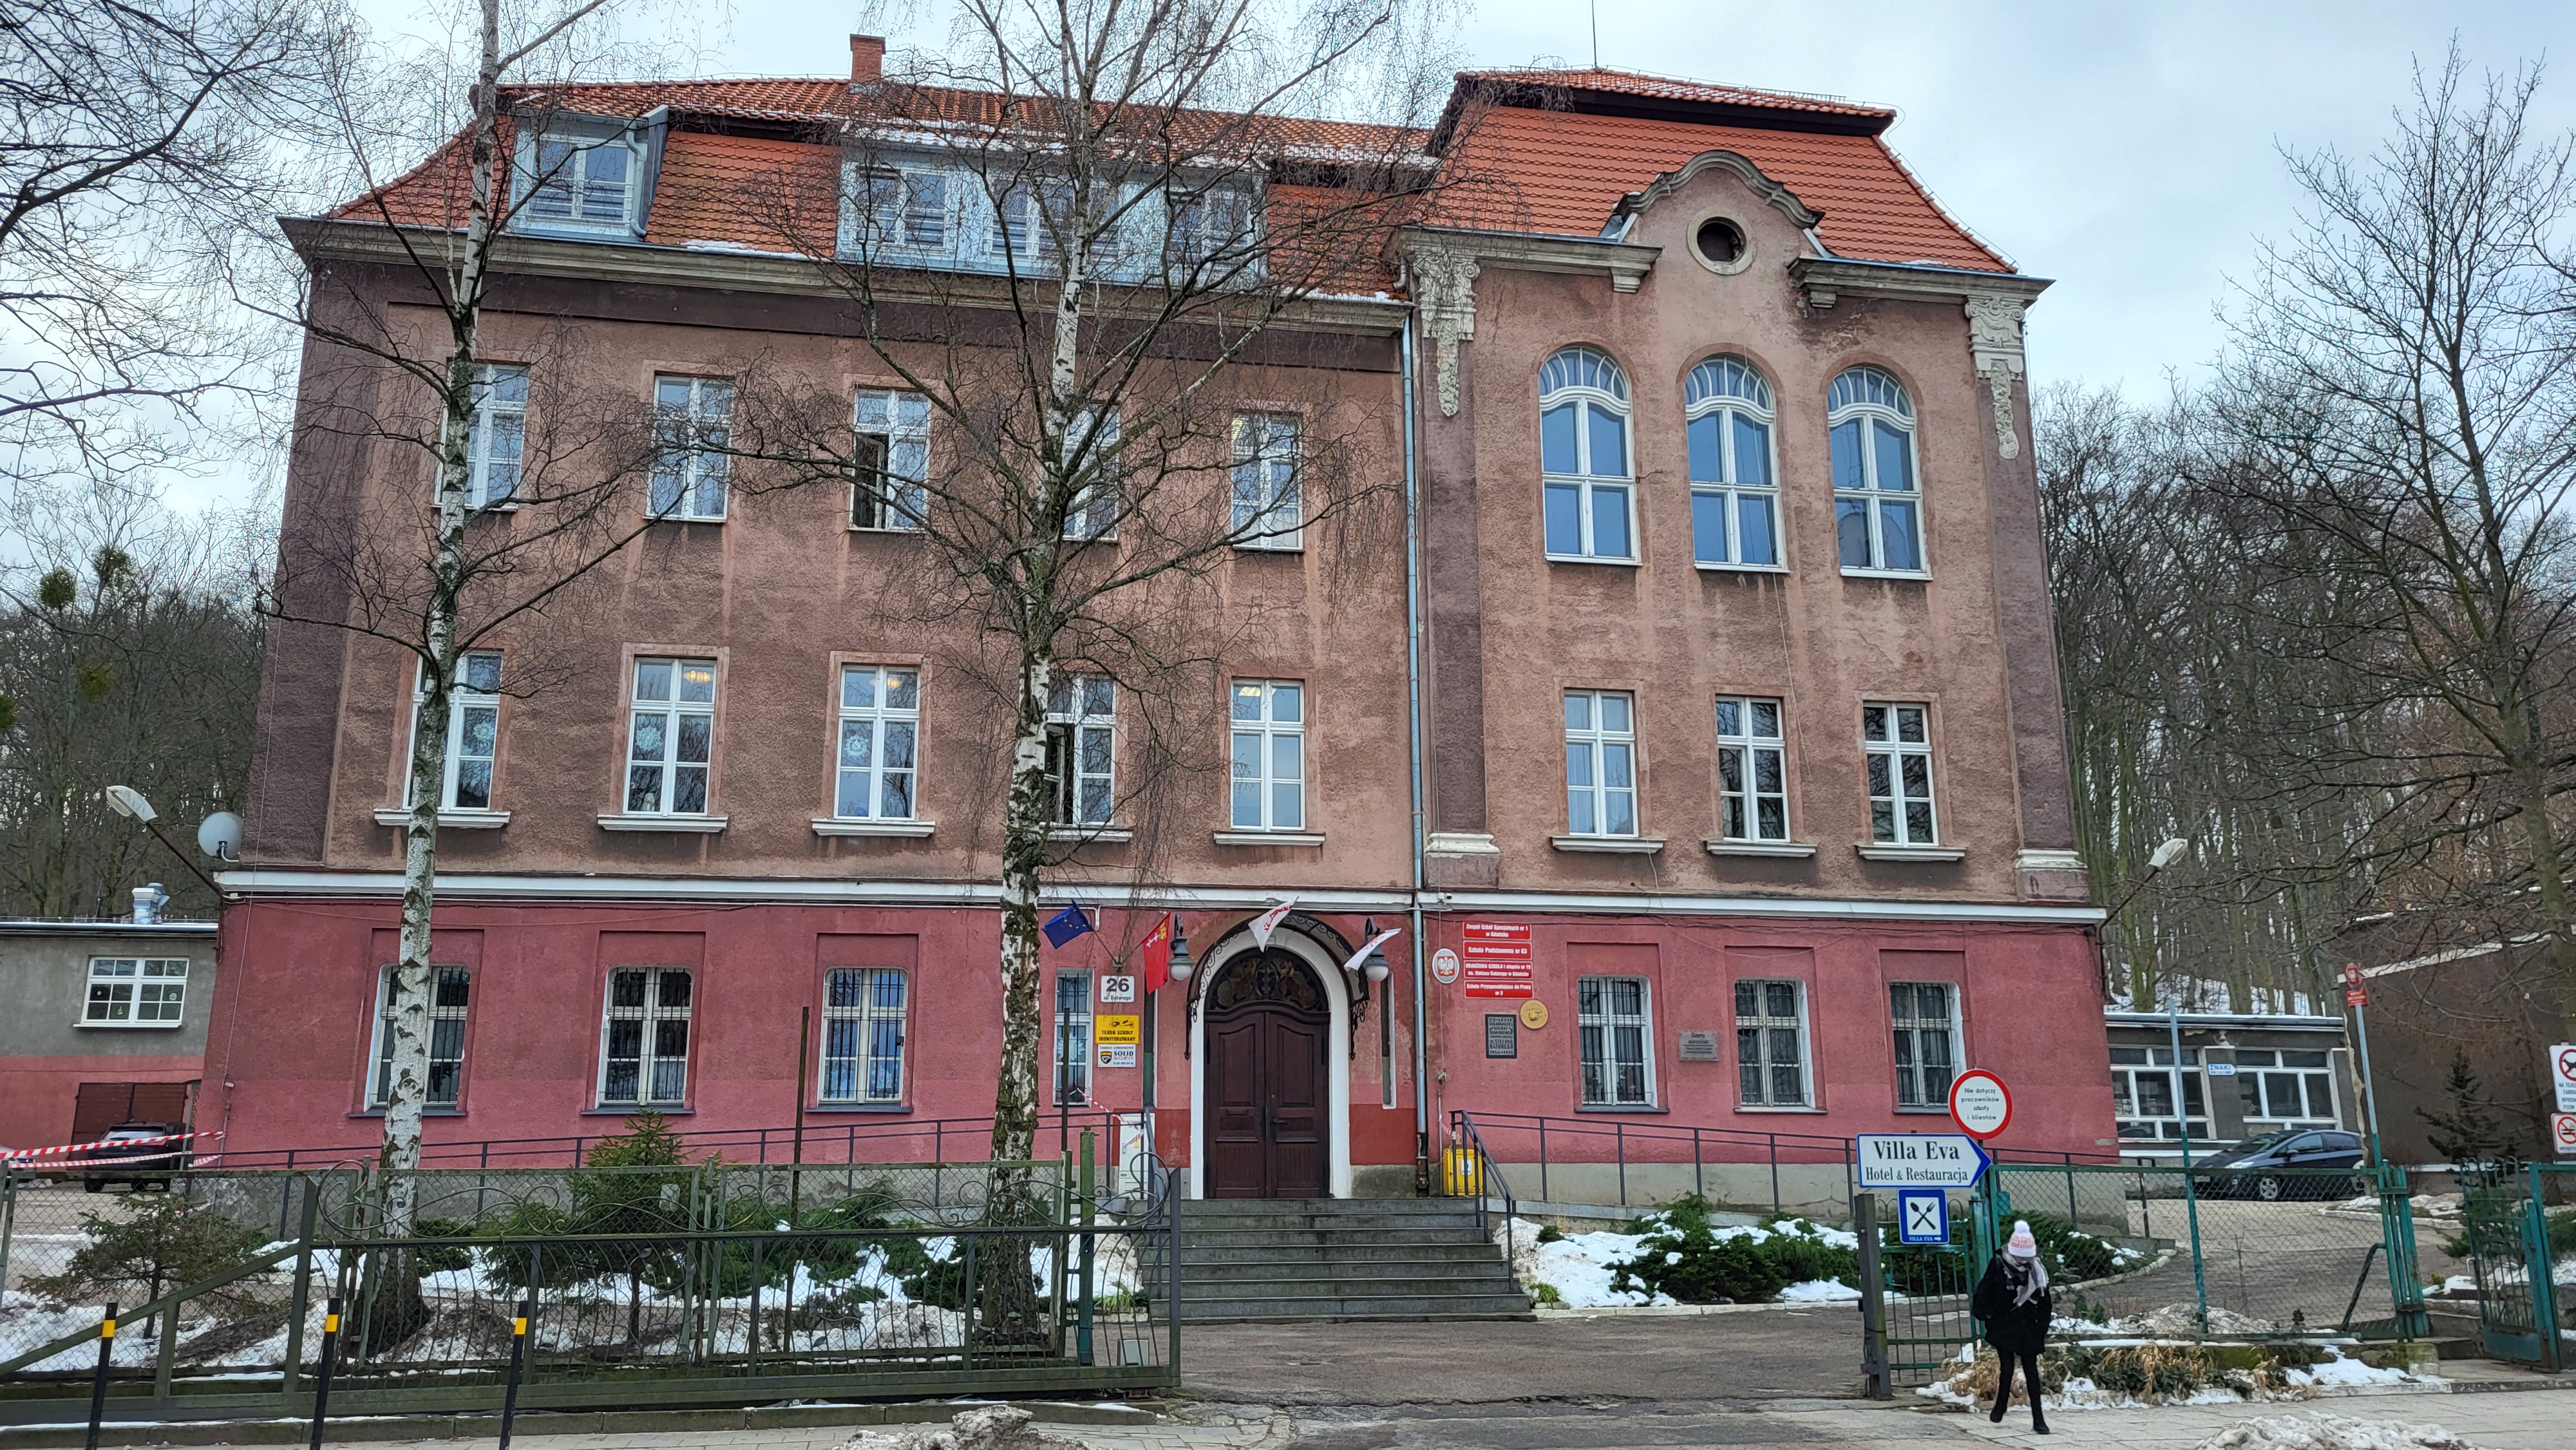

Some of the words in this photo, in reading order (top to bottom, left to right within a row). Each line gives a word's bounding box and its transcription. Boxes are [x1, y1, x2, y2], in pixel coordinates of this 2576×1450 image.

[1106, 978, 1129, 992] 26
[1873, 1141, 1917, 1159] Villa
[1925, 1141, 1960, 1159] Eva
[1866, 1167, 1893, 1180] Hotel
[1896, 1171, 1903, 1180] &
[1906, 1167, 1968, 1183] Restauracja
